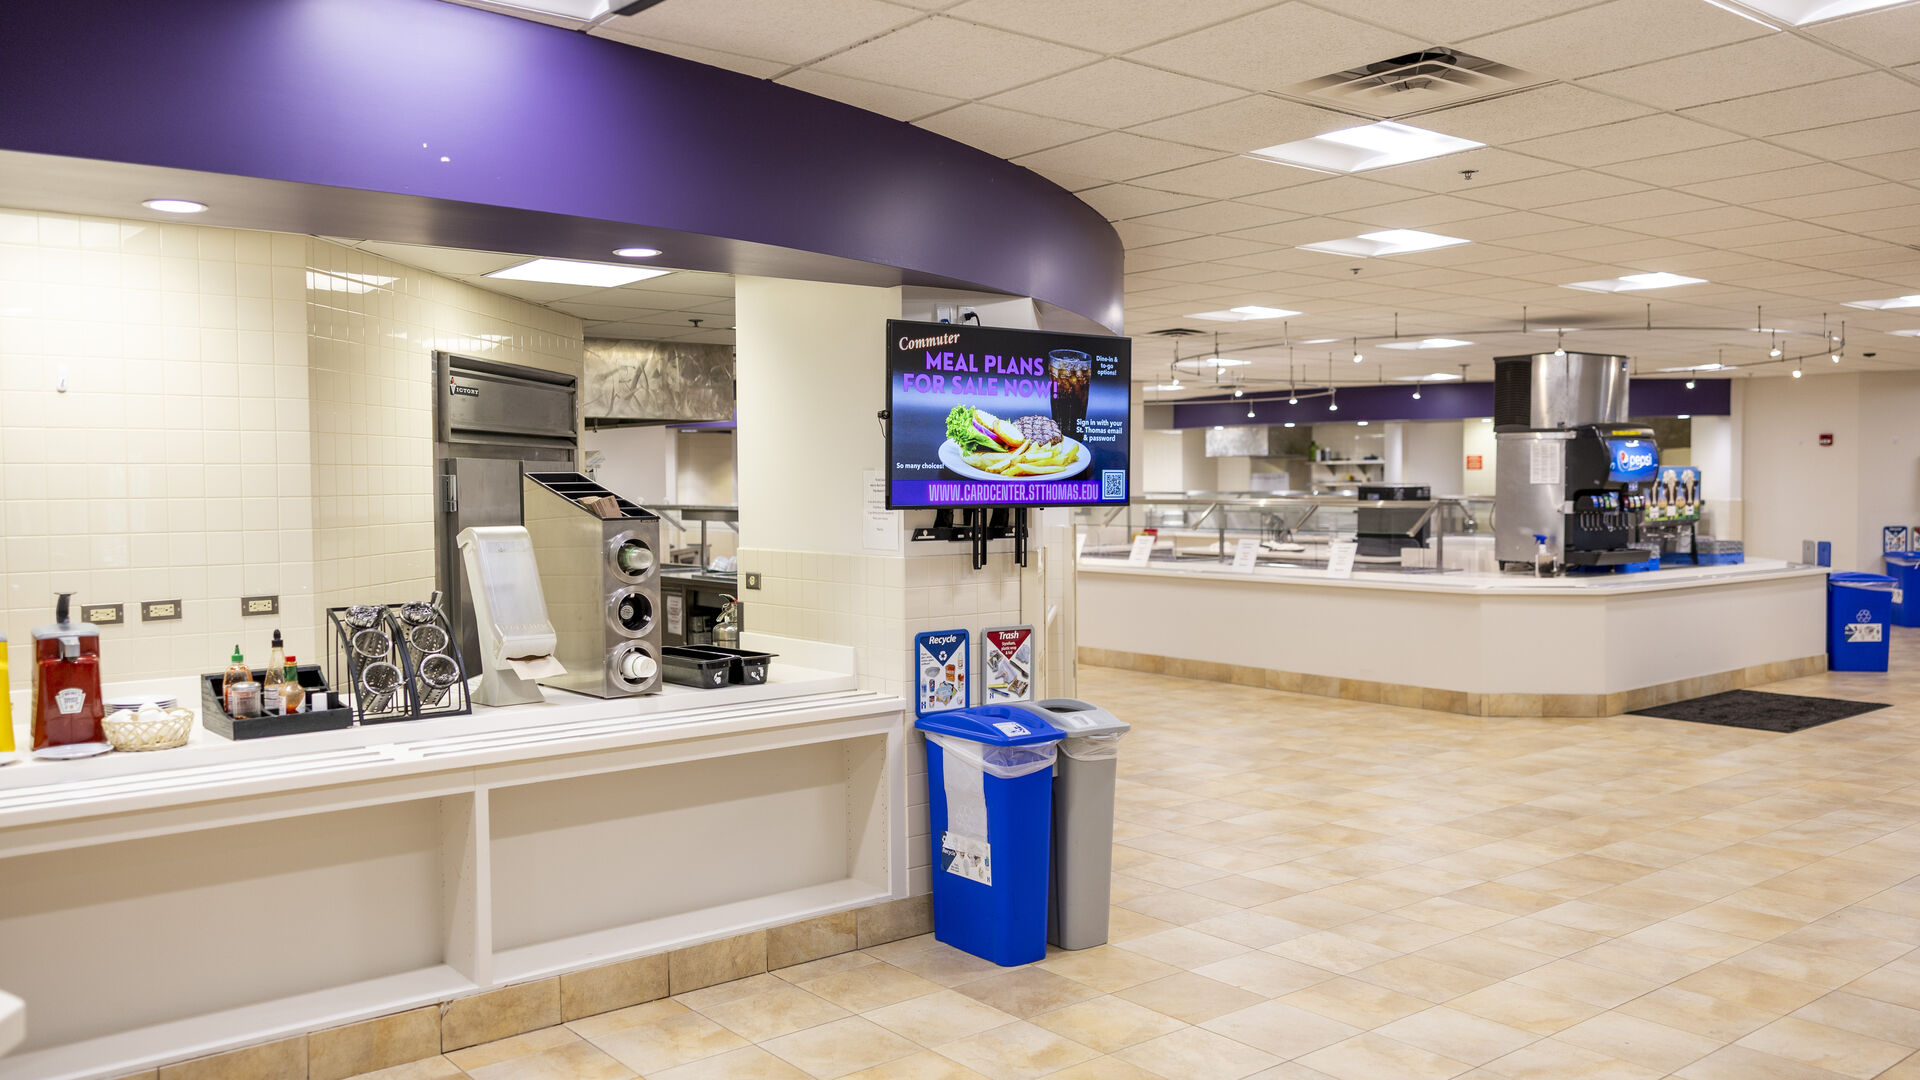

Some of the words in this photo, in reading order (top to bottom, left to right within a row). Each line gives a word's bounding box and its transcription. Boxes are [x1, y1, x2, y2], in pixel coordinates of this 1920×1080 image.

[899, 333, 960, 351] Commuter
[925, 351, 979, 372] MEAL
[984, 354, 1045, 377] PLANS
[1097, 369, 1117, 377] options!
[903, 372, 945, 394] FOR
[951, 375, 998, 397] SALE
[1004, 377, 1058, 400] NOW!
[1076, 418, 1089, 427] Sign
[1090, 418, 1096, 426] in
[1085, 426, 1106, 434] Thomas
[1089, 434, 1116, 443] password
[1629, 453, 1652, 468] pepsi
[928, 483, 1099, 502] WWW.CARDCENTER.STTHOMAS.EDU
[929, 635, 957, 645] Recycle
[999, 630, 1019, 640] Trash
